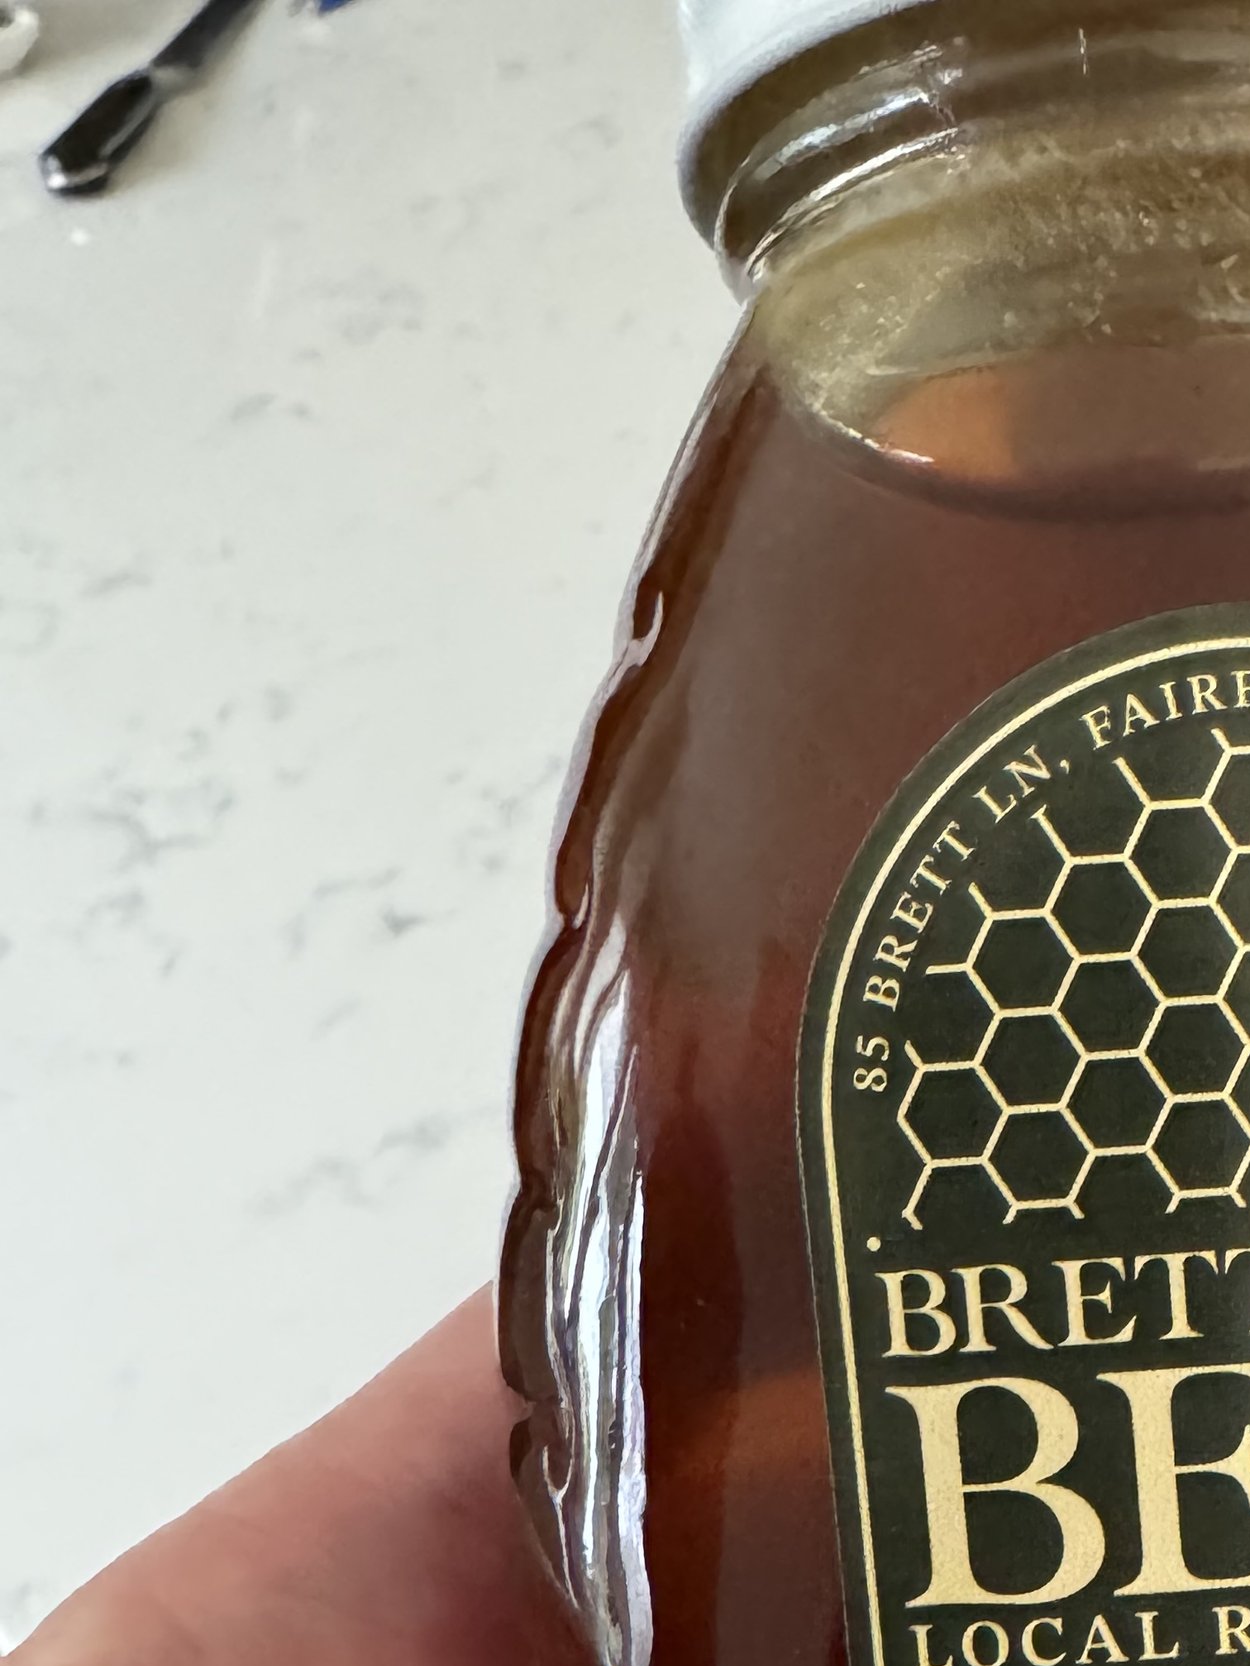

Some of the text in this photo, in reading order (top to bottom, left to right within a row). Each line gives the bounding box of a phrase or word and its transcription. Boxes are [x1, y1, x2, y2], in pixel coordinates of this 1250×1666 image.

[972, 742, 1072, 827] LN,
[862, 820, 979, 1014] BRETT
[851, 1033, 890, 1094] 85
